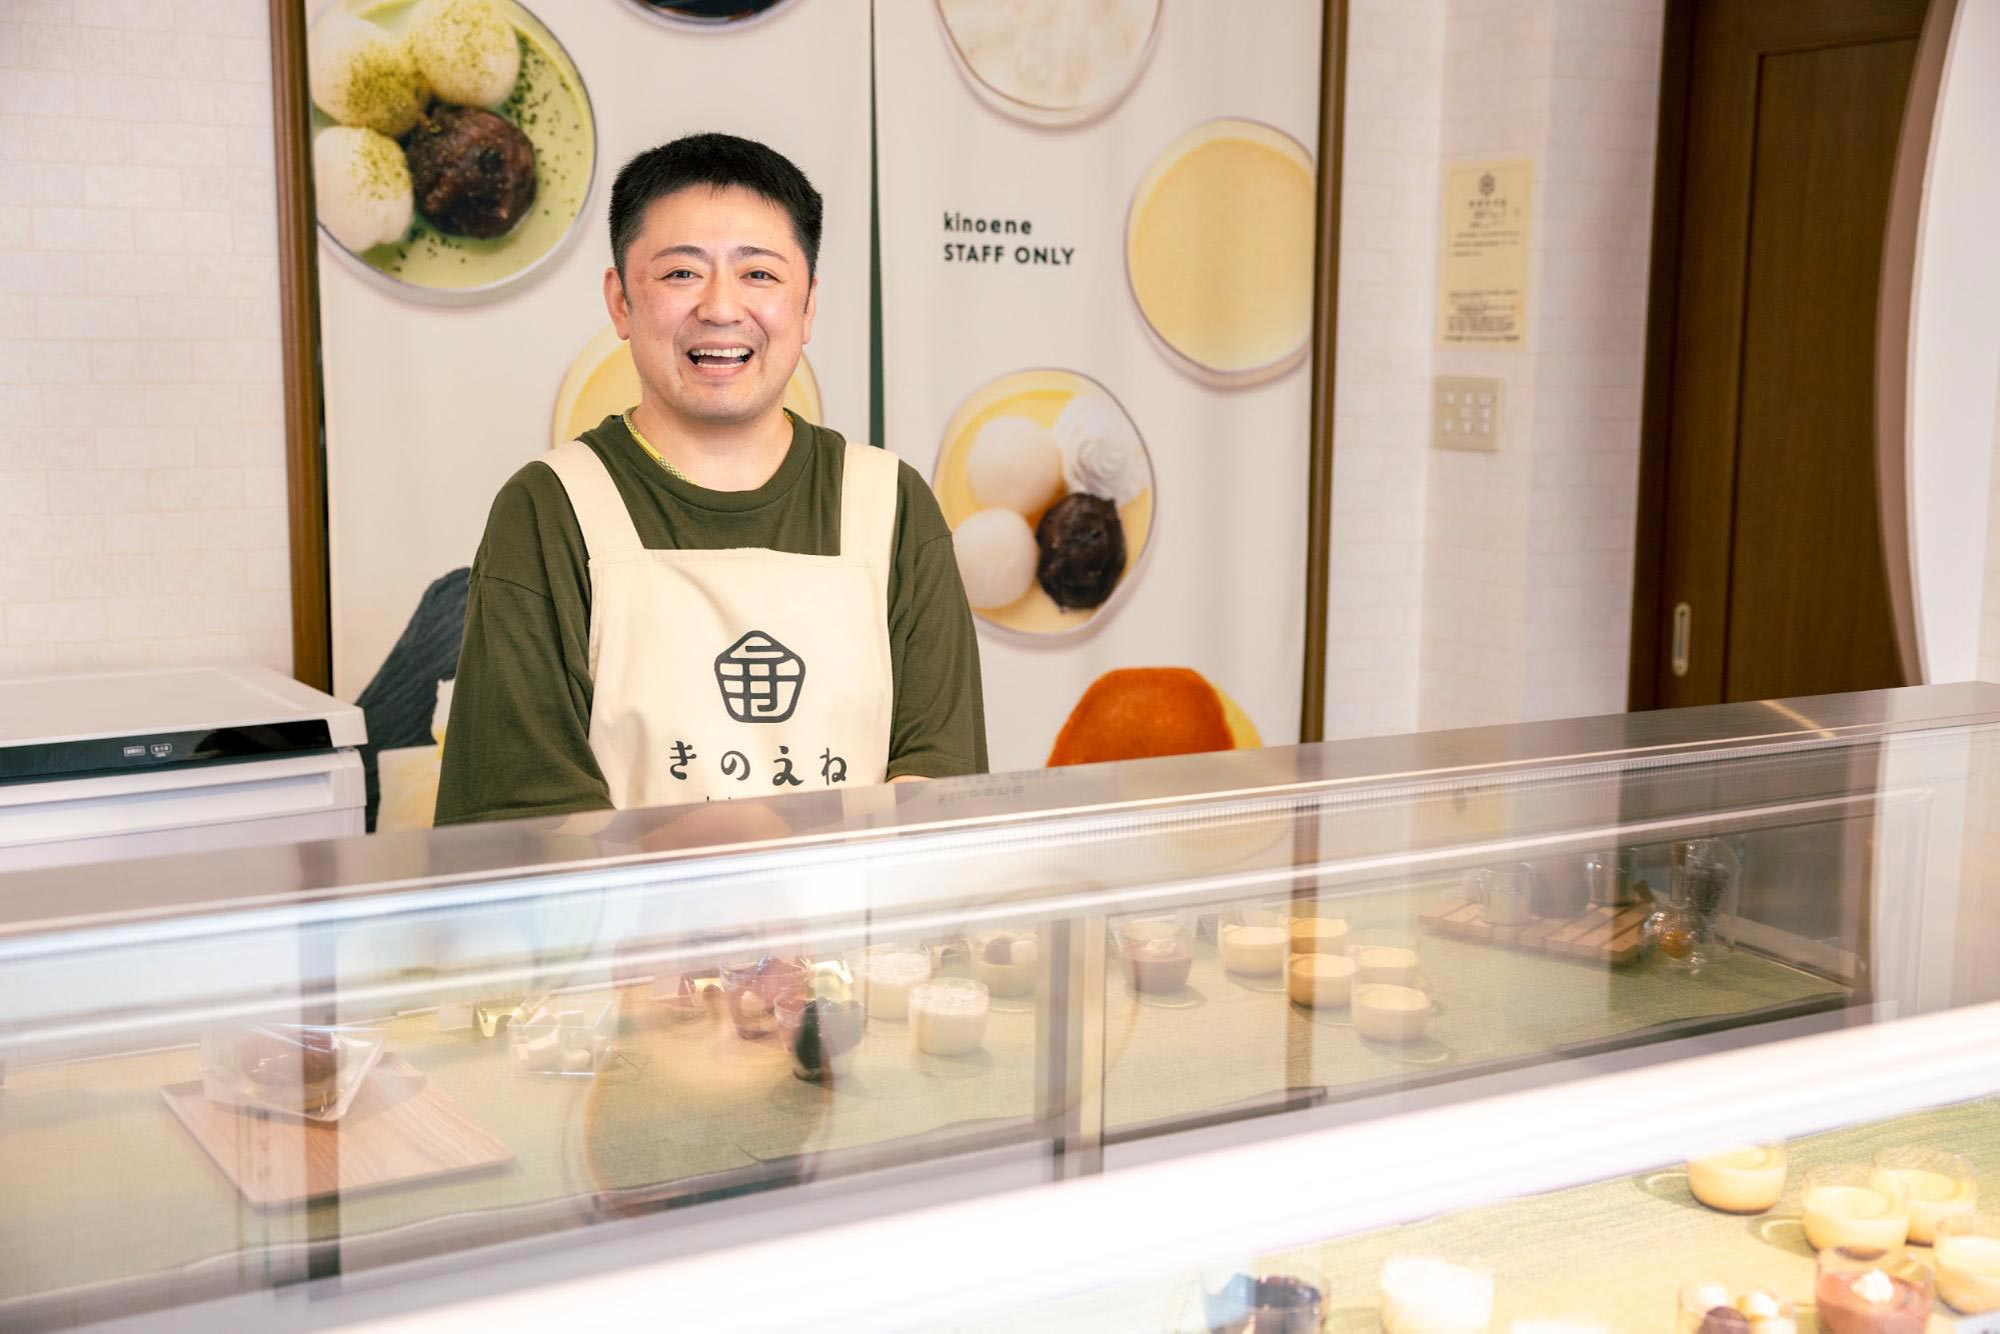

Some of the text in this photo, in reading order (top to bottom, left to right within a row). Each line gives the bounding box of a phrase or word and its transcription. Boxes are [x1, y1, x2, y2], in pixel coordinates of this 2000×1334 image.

[944, 212, 1032, 235] kinoene
[944, 243, 1074, 265] STAFF ONLY
[670, 741, 846, 786] きのえね
